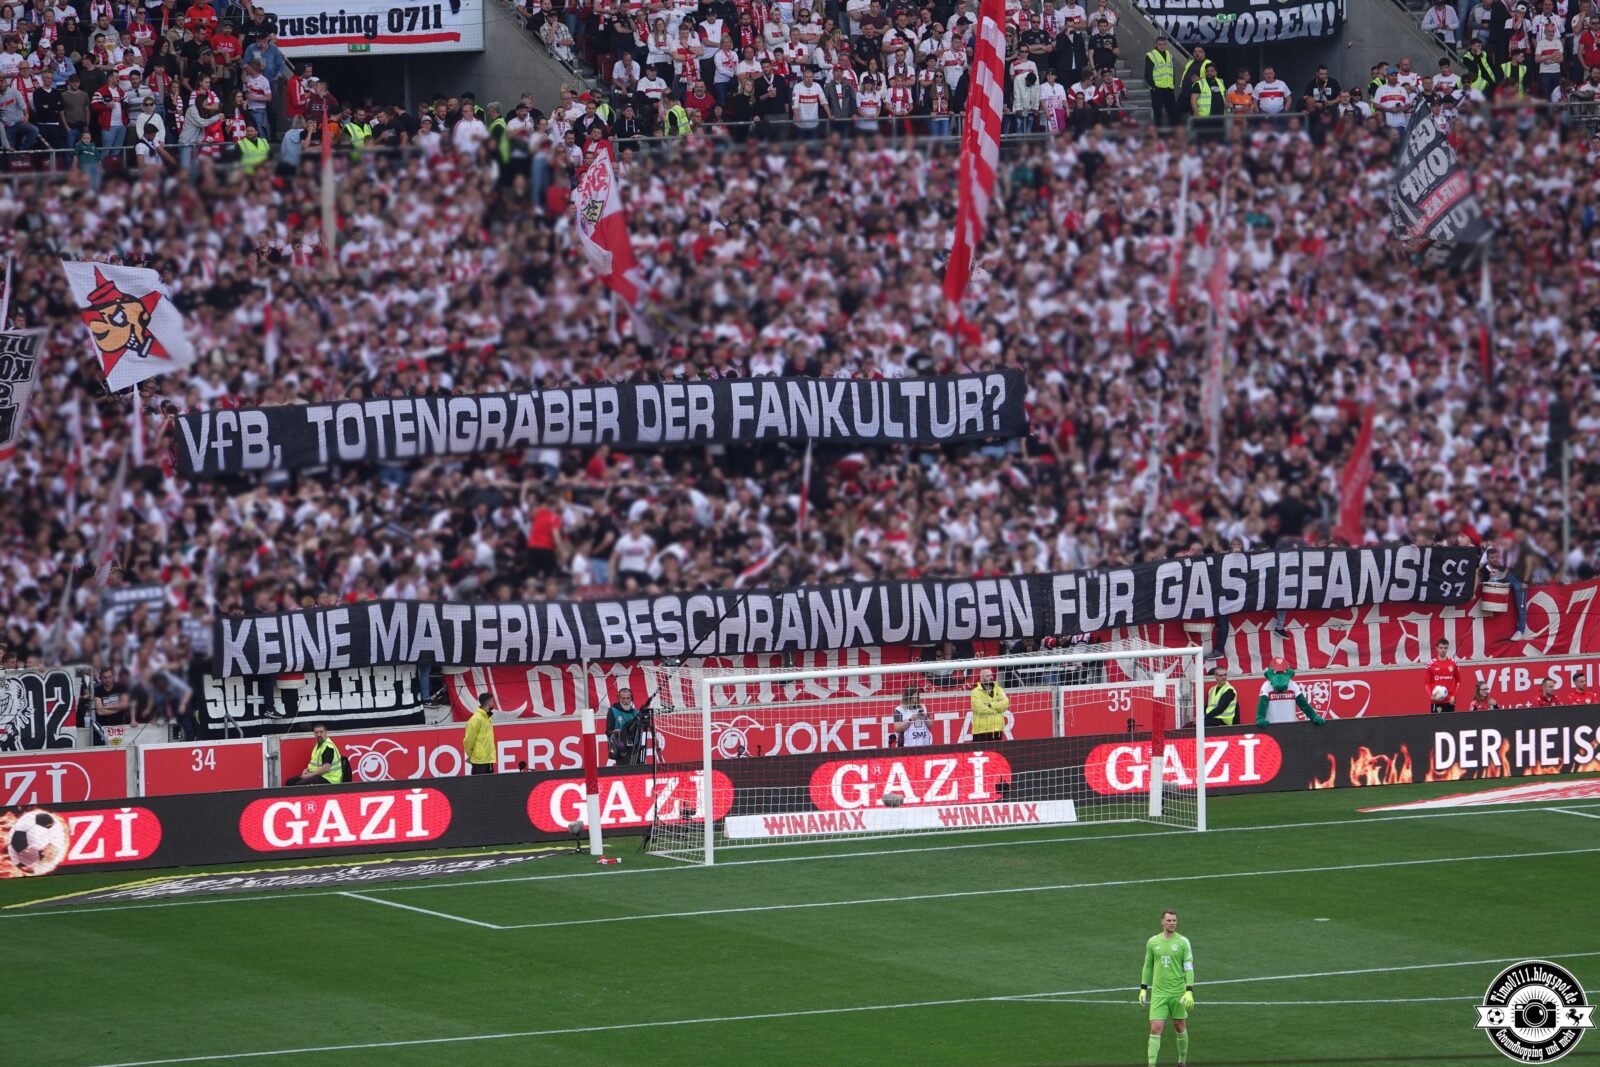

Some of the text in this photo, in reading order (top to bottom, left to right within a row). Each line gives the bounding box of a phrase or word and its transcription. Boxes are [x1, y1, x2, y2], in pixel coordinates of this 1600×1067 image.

[387, 4, 443, 33] 0711
[1152, 1, 1336, 44] VESTOREN!
[178, 374, 1006, 472] VfB, TOTENGRÄBER DER FANKULTUR?
[1441, 558, 1469, 577] CC
[1439, 581, 1465, 598] 97
[222, 546, 1431, 678] KEINE MATERIALBESCHRÄNKUNGEN FÜR GÄSTEFANS!
[1522, 585, 1598, 657] 97
[1475, 662, 1600, 693] VfB-STI
[1108, 690, 1131, 713] 35
[191, 748, 217, 772] 34
[1435, 728, 1502, 770] DER
[763, 811, 866, 836] WINAMAX
[938, 803, 1040, 827] WINAMAX
